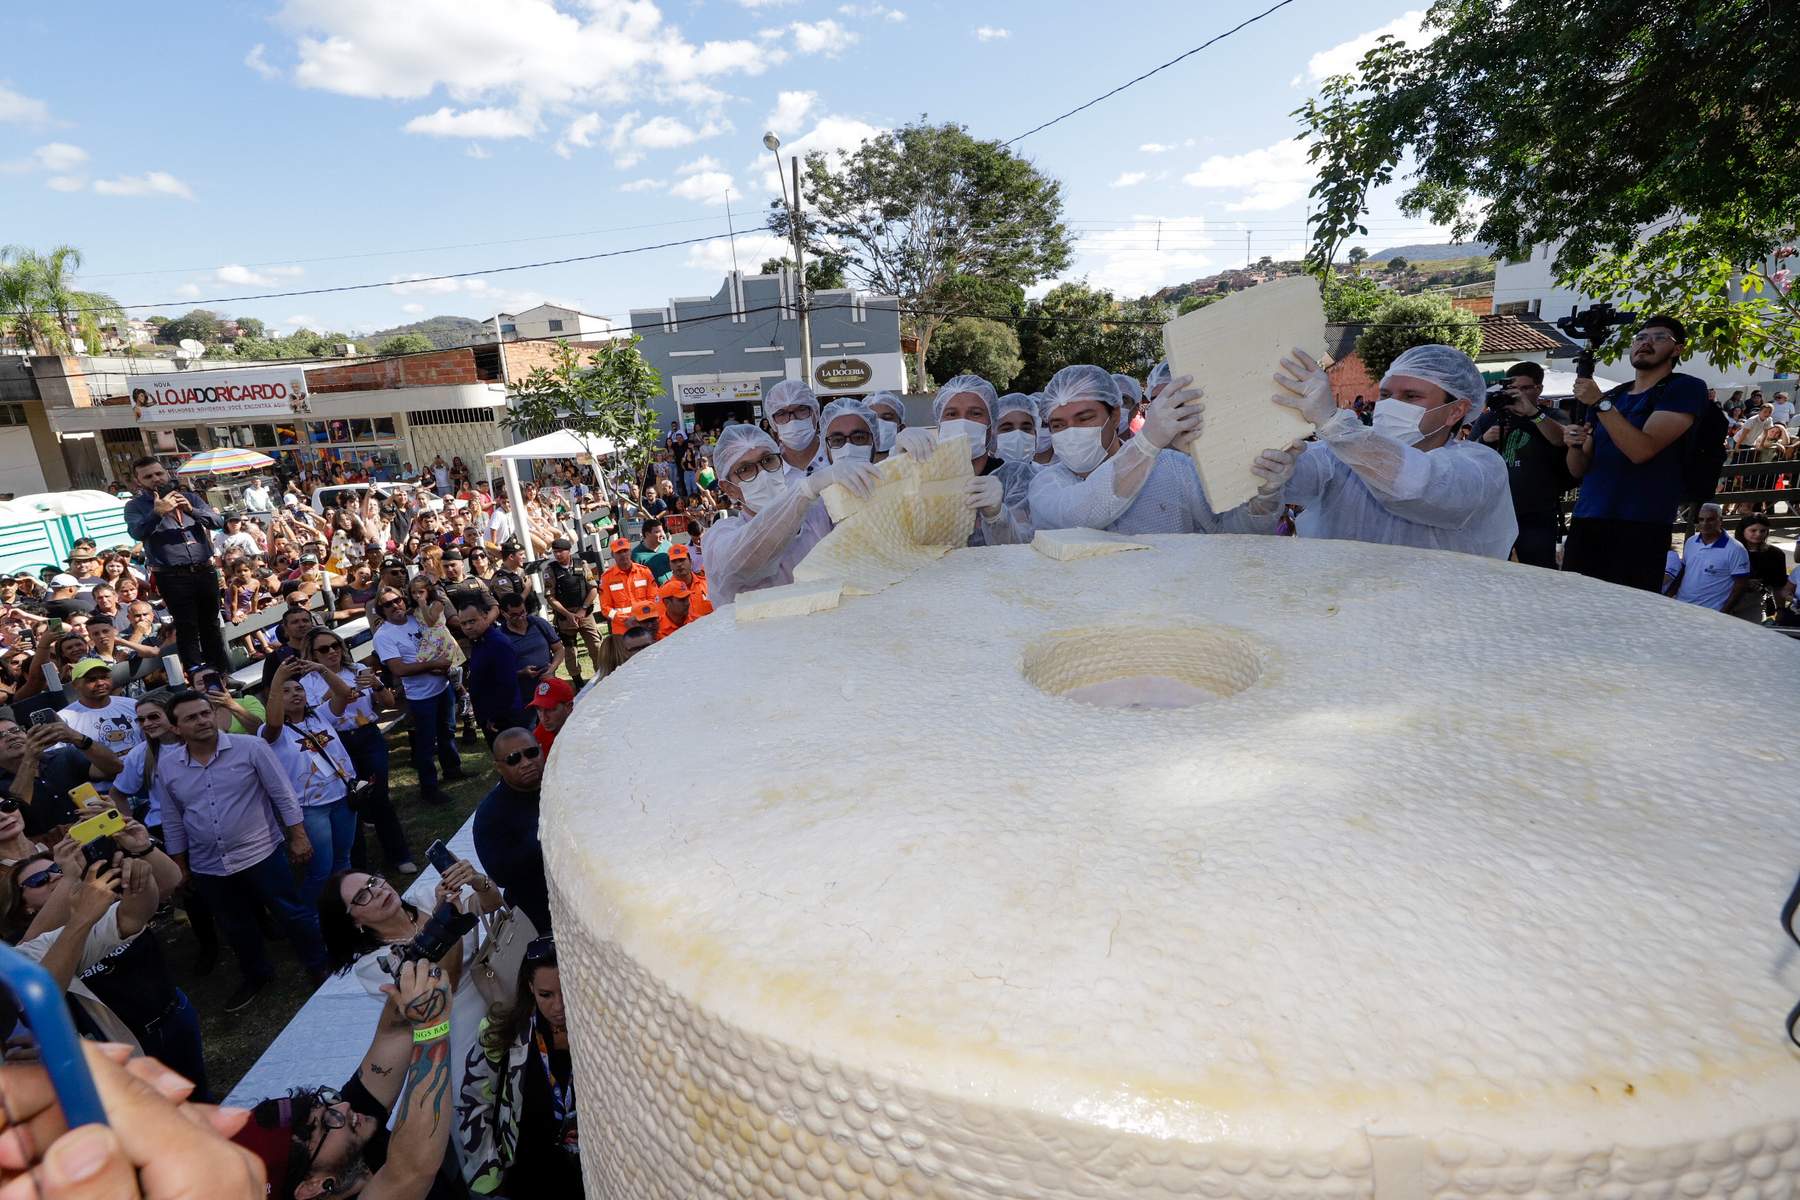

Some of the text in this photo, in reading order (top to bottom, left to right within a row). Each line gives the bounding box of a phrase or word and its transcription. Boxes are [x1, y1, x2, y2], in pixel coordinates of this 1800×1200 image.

[832, 368, 865, 376] DOCERIA
[244, 402, 273, 410] ENCONTRA
[80, 962, 108, 980] afé.
